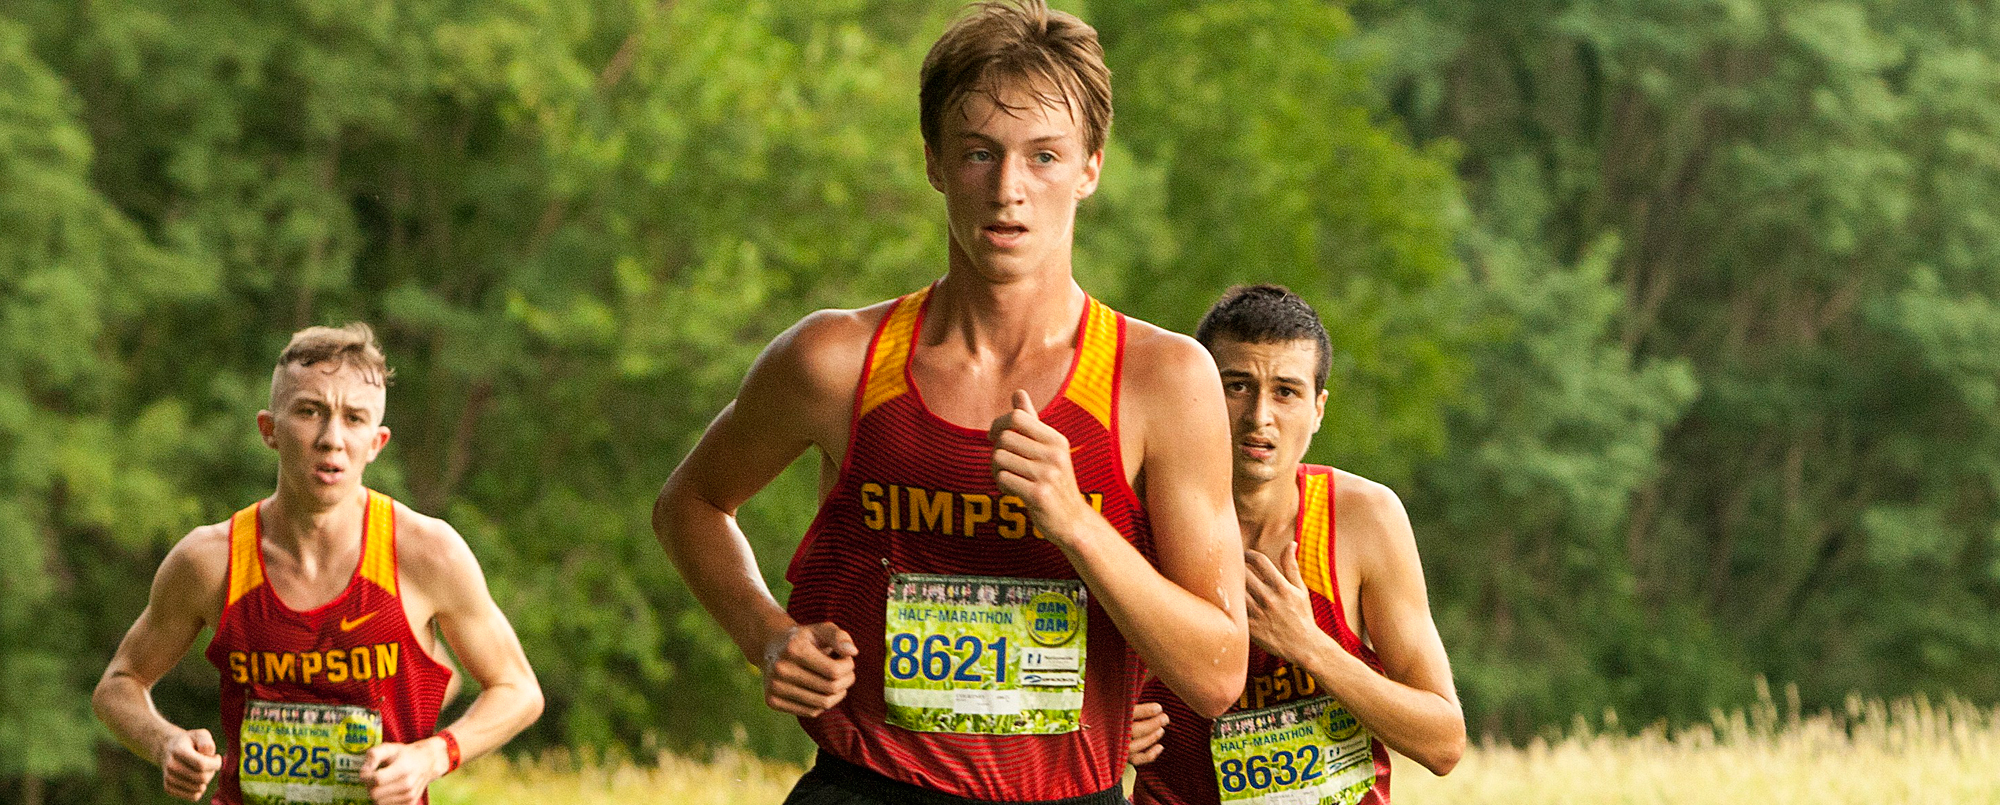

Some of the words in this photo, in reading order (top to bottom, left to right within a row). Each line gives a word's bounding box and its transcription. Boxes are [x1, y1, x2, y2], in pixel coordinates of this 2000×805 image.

[861, 483, 1103, 539] SIMPS
[899, 608, 1013, 625] HALF-MARATHON
[1034, 618, 1069, 632] DAM
[1036, 602, 1068, 614] DAM
[229, 642, 399, 684] SIMPSON
[889, 633, 1007, 683] 8621
[1220, 725, 1314, 753] HALF-MARATHON
[243, 742, 331, 779] 8625
[1220, 744, 1323, 793] 8632
